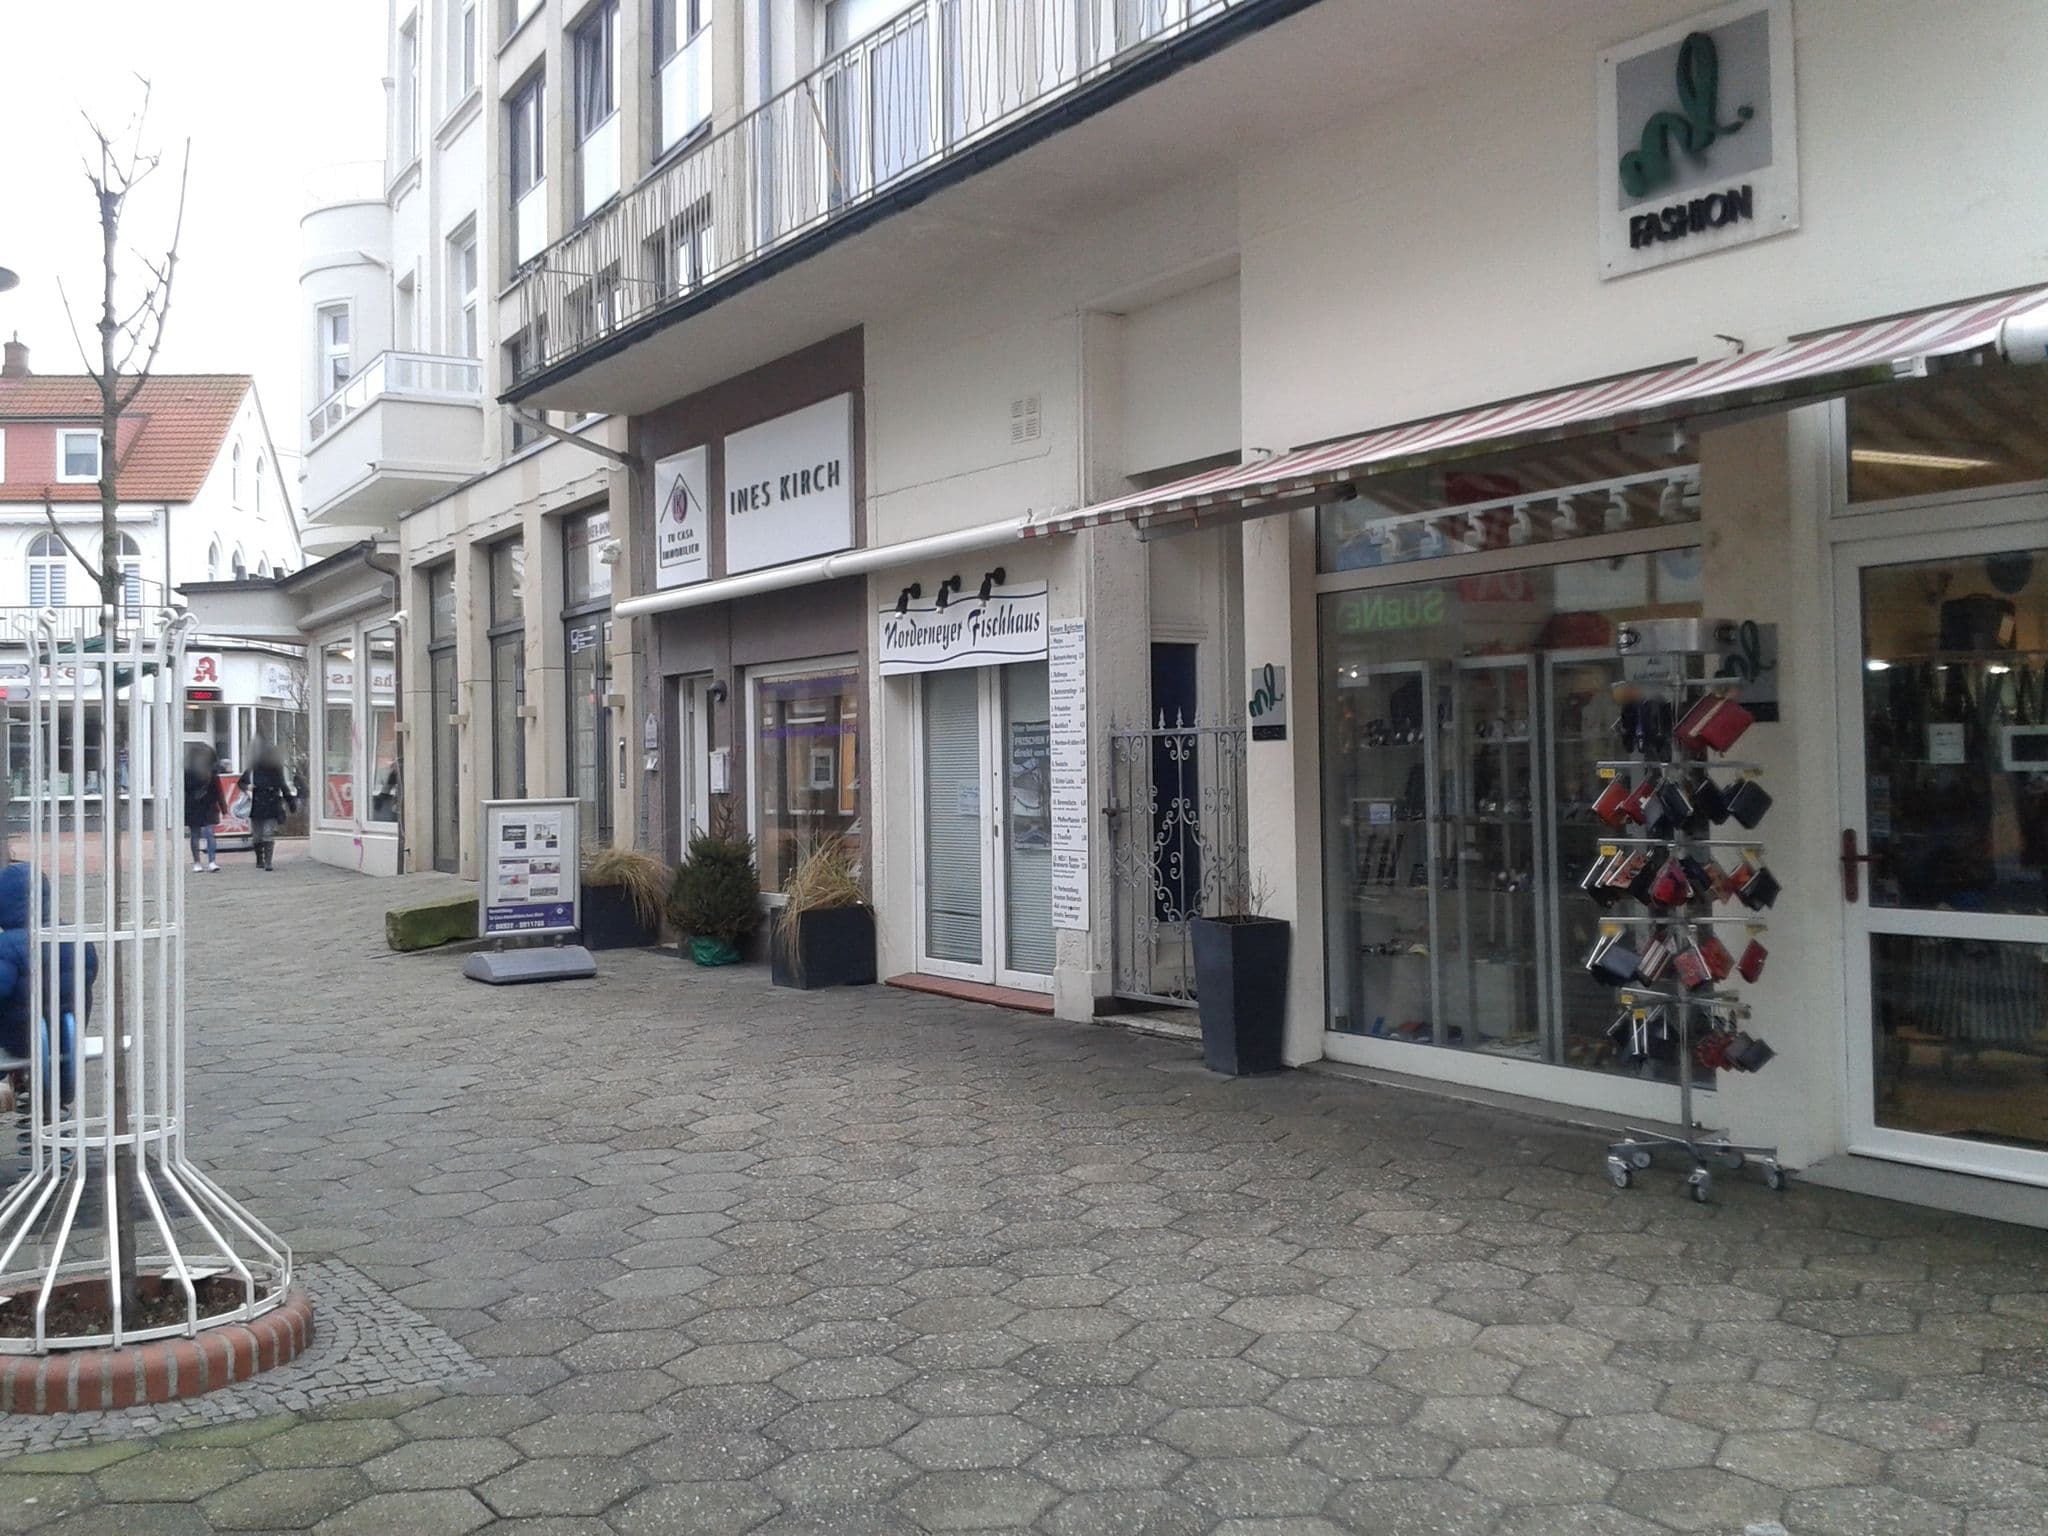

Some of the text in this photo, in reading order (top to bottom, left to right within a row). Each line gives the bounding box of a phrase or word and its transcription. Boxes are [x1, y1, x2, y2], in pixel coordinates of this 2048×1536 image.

[1629, 184, 1753, 249] FASHION
[730, 459, 840, 515] INES KIRCH
[662, 543, 699, 560] IMMOBILIEN
[667, 528, 694, 543] TU CASA
[884, 603, 1040, 650] Norderneyer Fischhaus
